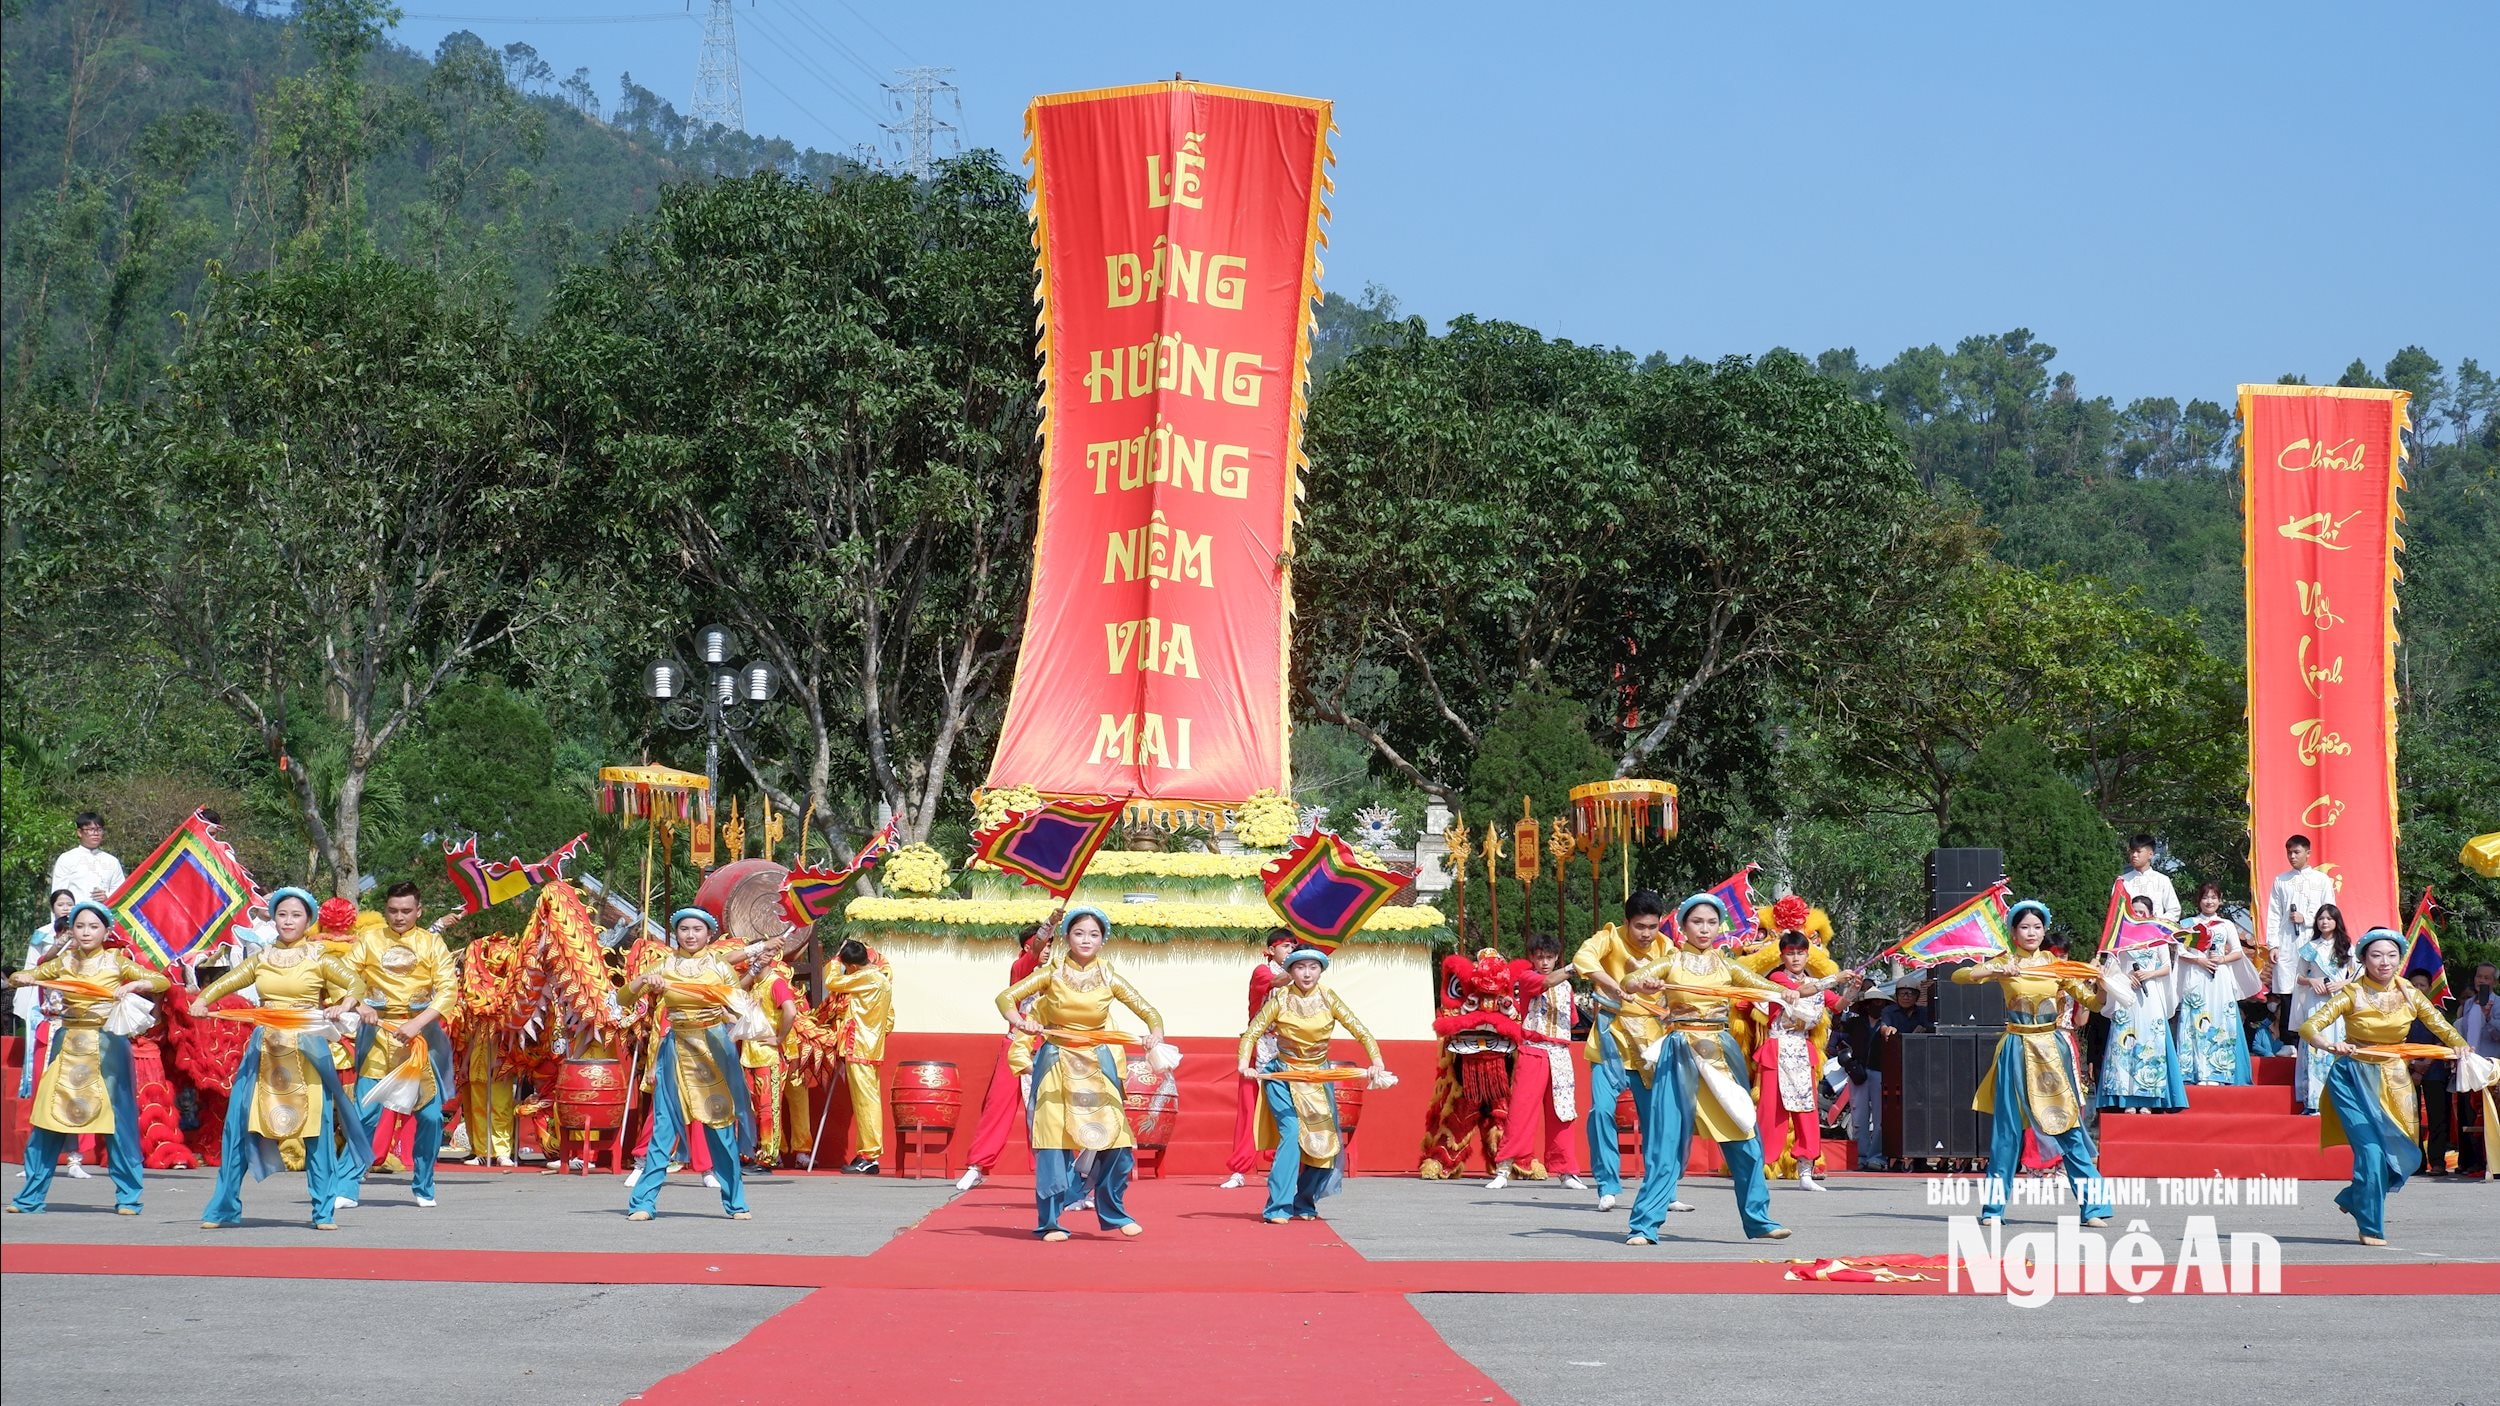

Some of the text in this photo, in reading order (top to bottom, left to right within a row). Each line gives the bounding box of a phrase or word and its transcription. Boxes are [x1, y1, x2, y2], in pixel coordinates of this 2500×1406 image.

[1146, 131, 1206, 209] LỄ
[1105, 234, 1247, 310] DÂNG
[1083, 331, 1262, 407] HƯƠNG
[2277, 438, 2366, 472] Chính
[1102, 510, 1214, 589] NIỆM
[2278, 510, 2363, 551] Khí
[1105, 617, 1201, 679] VUA
[2298, 635, 2343, 699] Linh
[1087, 713, 1192, 770] MAI
[2290, 718, 2351, 767] Thiên
